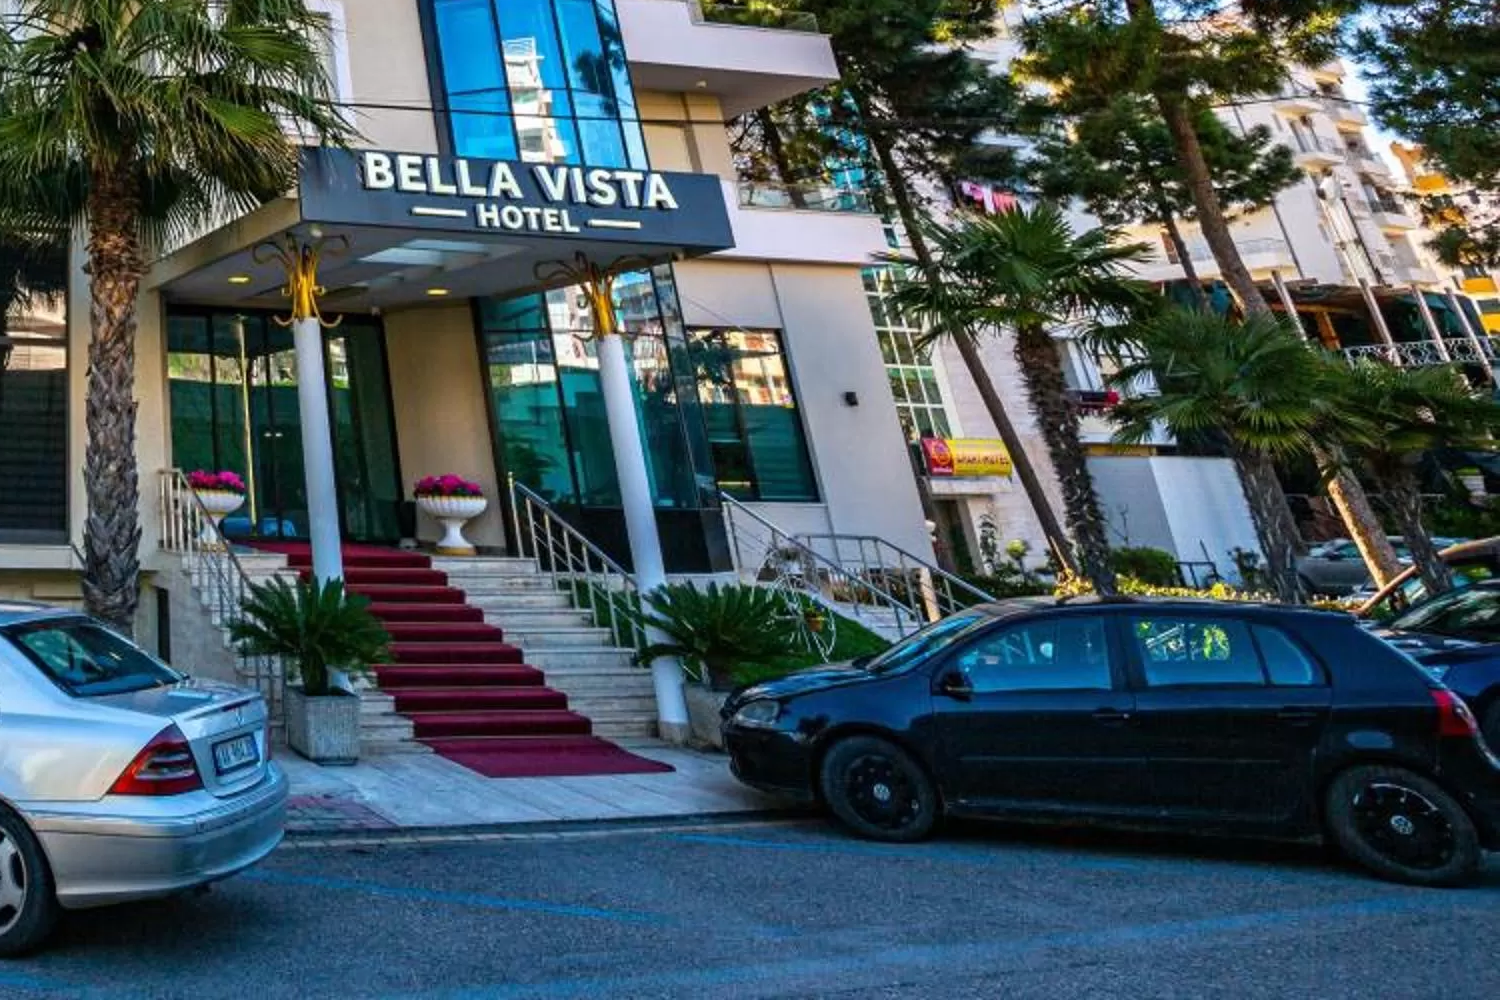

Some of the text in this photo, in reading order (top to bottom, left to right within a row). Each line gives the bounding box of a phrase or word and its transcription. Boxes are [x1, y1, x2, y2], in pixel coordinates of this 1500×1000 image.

[362, 152, 679, 209] BELLA VISTA
[476, 204, 580, 233] HOTEL
